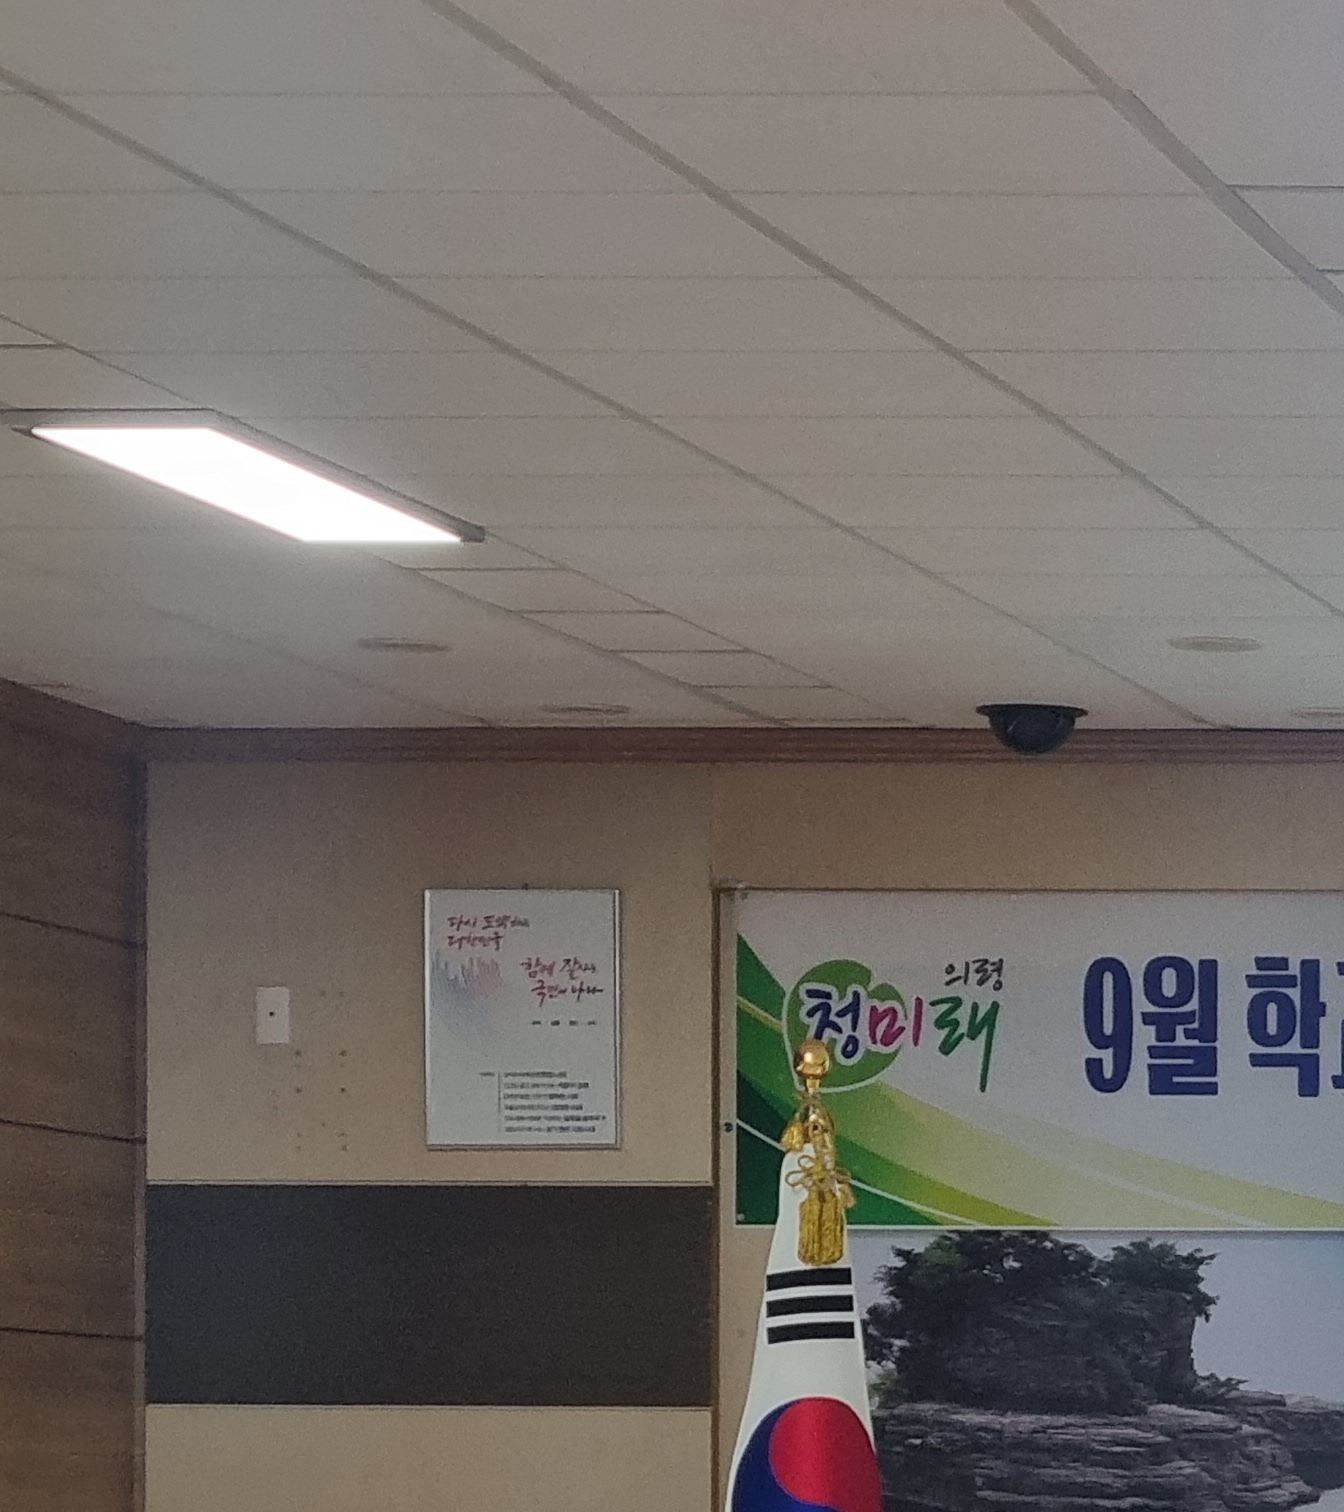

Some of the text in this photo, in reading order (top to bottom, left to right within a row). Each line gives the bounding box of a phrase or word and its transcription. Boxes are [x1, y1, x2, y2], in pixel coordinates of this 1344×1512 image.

[943, 957, 1004, 991] 의령
[1084, 956, 1220, 1097] 9월
[803, 986, 1000, 1093] 청미래
